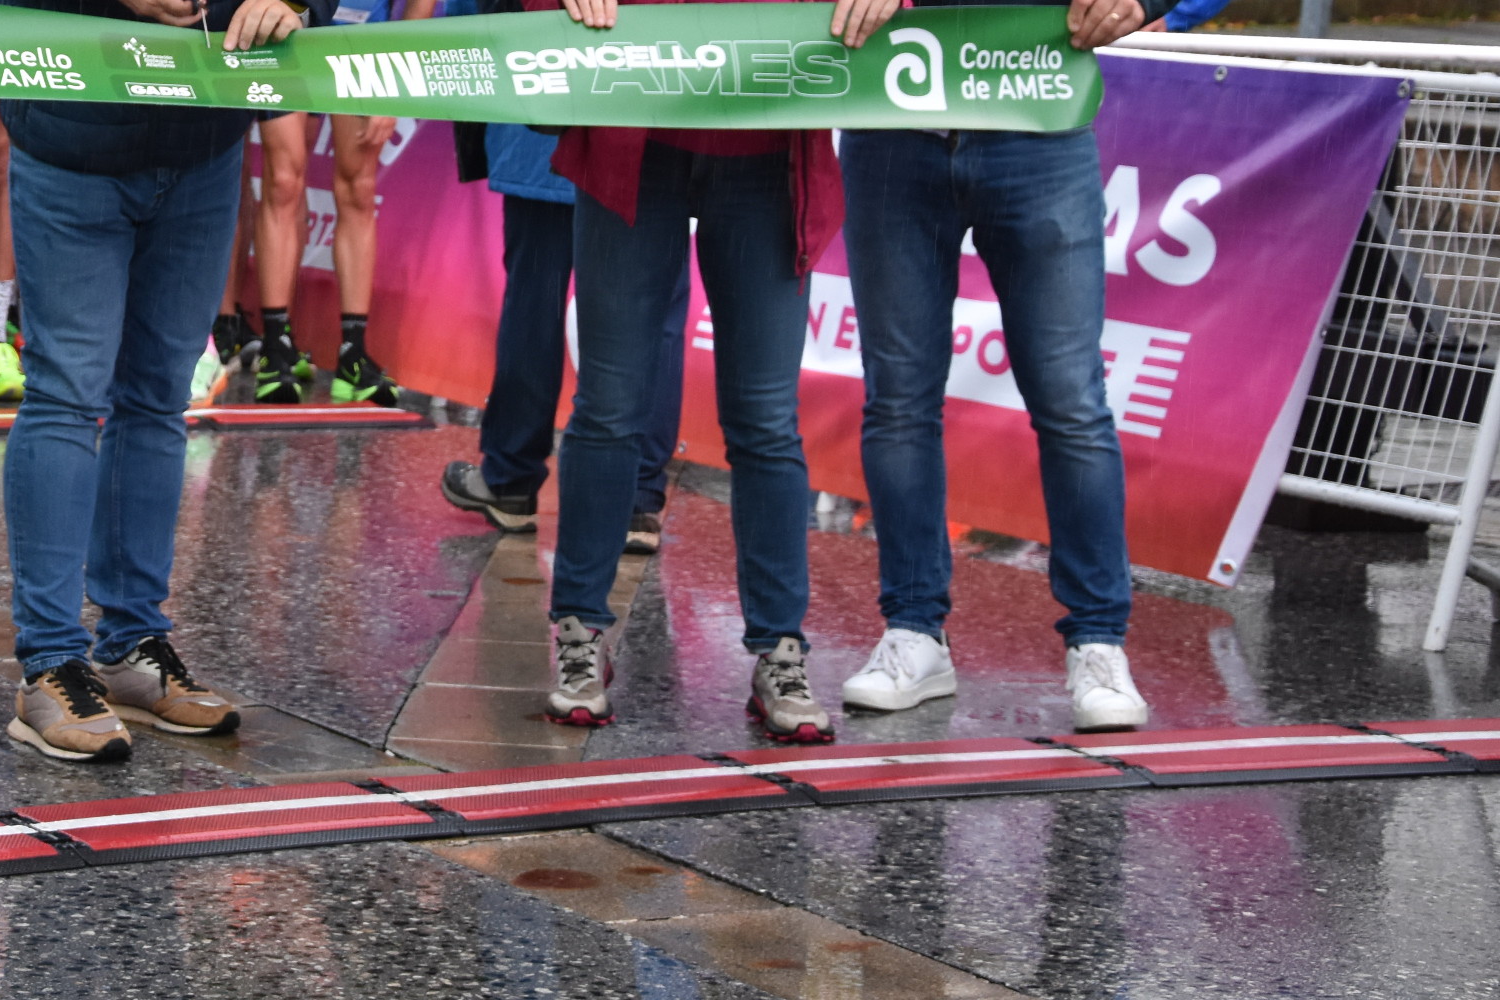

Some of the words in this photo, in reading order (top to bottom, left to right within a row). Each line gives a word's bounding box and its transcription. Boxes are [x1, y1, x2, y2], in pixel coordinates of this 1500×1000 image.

[420, 47, 493, 65] CARREIRA
[505, 44, 726, 72] CONCELLO
[959, 41, 1063, 71] Concello
[0, 68, 86, 92] AMES
[325, 51, 429, 98] XXIV
[425, 62, 499, 81] PEDESTRE
[512, 71, 570, 96] DE
[590, 40, 851, 98] AMES
[130, 84, 191, 97] GADIS
[428, 80, 495, 97] POPULAR
[960, 74, 991, 100] de
[998, 73, 1074, 100] AMES
